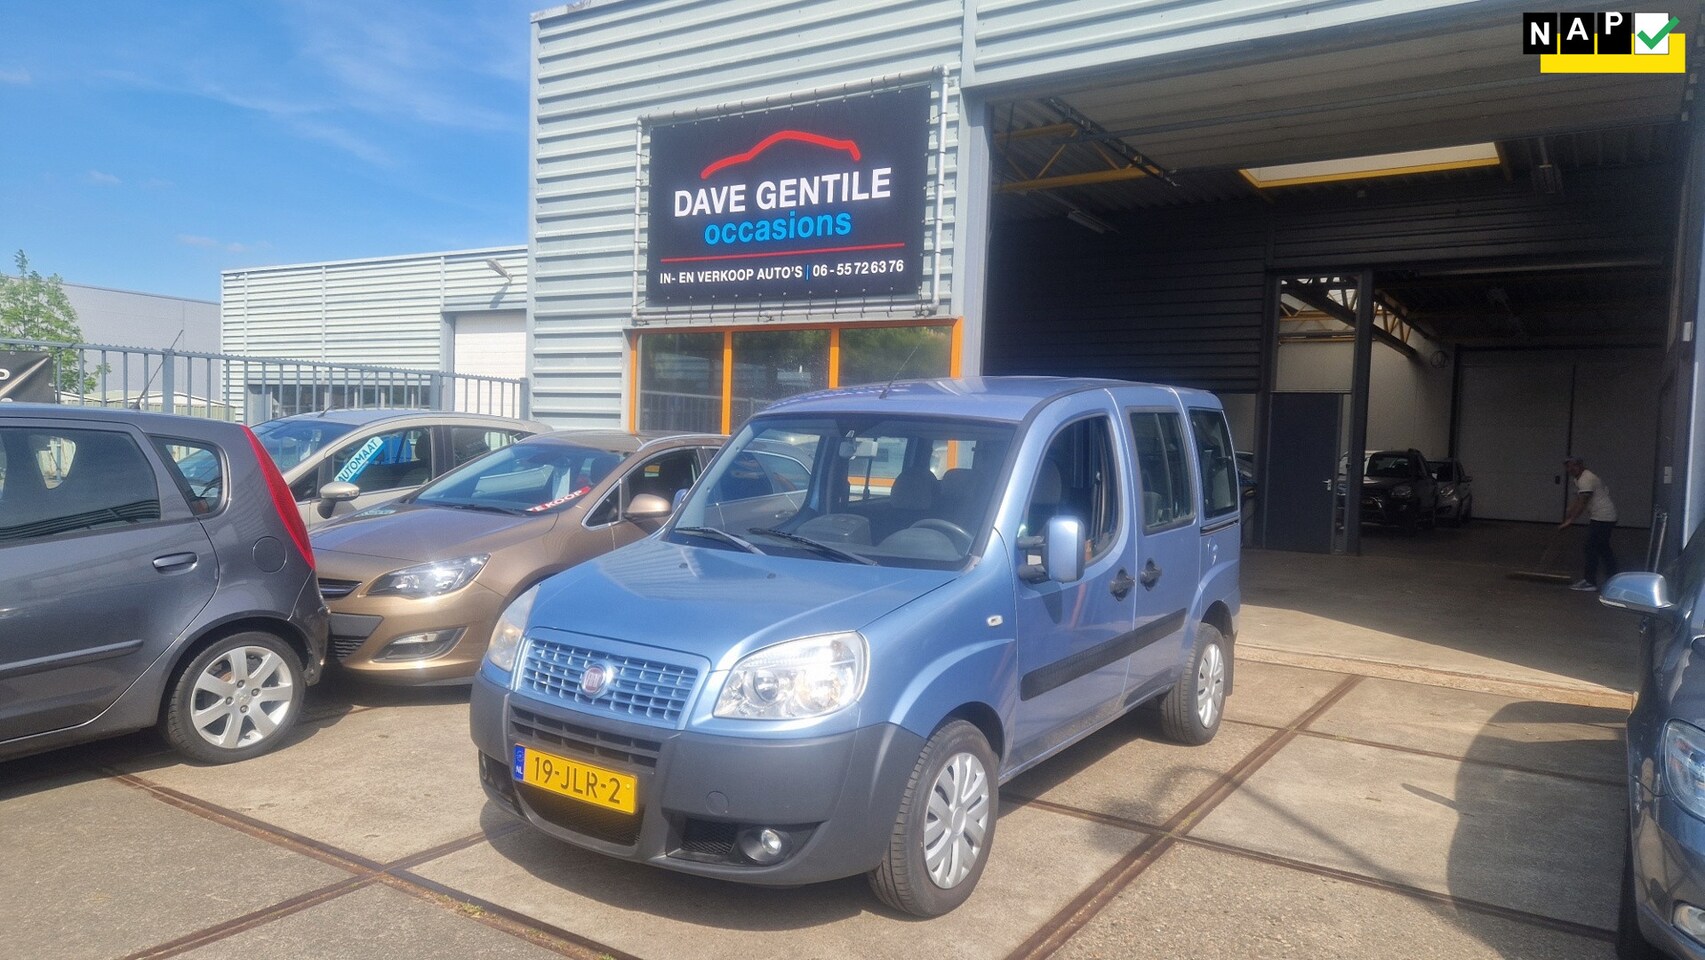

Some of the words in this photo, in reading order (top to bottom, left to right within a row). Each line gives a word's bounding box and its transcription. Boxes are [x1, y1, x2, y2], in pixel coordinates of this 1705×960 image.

[674, 183, 747, 218] DAVE
[755, 167, 892, 211] GENTILE
[704, 211, 852, 245] occasions
[659, 272, 677, 285] IN-
[678, 271, 695, 284] EN
[696, 268, 754, 283] VERKOOP
[756, 265, 804, 281] AUTO'S
[338, 438, 379, 482] AUTOMAAT
[515, 765, 523, 775] NL
[534, 756, 621, 804] 19-JLR-2
